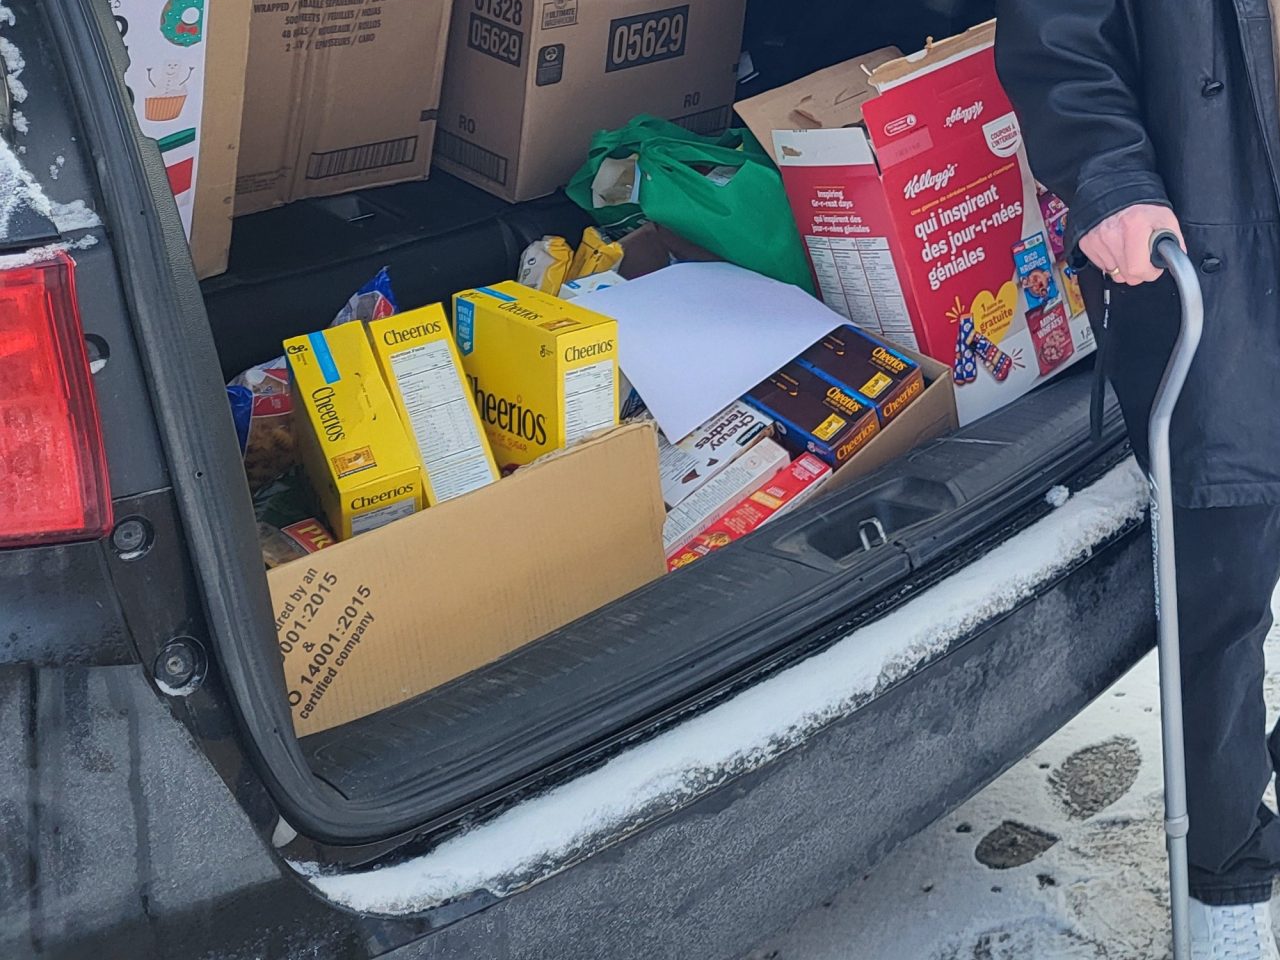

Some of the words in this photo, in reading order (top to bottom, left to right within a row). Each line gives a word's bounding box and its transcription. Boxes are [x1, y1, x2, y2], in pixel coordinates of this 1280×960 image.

[253, 1, 290, 14] WRAPPED
[471, 19, 521, 61] 05629
[612, 13, 684, 65] 05629
[683, 91, 700, 109] RO
[458, 114, 476, 134] RO
[903, 162, 957, 200] Kellogg's
[914, 211, 939, 242] qui
[937, 184, 999, 228] inspirent
[921, 239, 948, 263] des
[947, 201, 1023, 255] jour-r-nées
[927, 246, 986, 291] géniales
[498, 301, 541, 321] Cheerios
[979, 308, 1013, 334] gratuite
[383, 321, 442, 347] Cheerios
[564, 339, 614, 363] Cheerios
[871, 346, 907, 373] Cheerios
[311, 386, 346, 442] Cheerios
[826, 386, 863, 413] Cheerios
[882, 380, 920, 418] Cheerios
[694, 409, 749, 450] Tendres
[709, 413, 755, 452] Chewy
[836, 422, 876, 461] Cheerios
[350, 483, 413, 511] Cheerios
[289, 585, 308, 603] by
[303, 567, 319, 585] an
[301, 584, 371, 686] 14001:2015
[302, 640, 316, 653] &
[299, 666, 338, 720] certified
[335, 610, 375, 668] company
